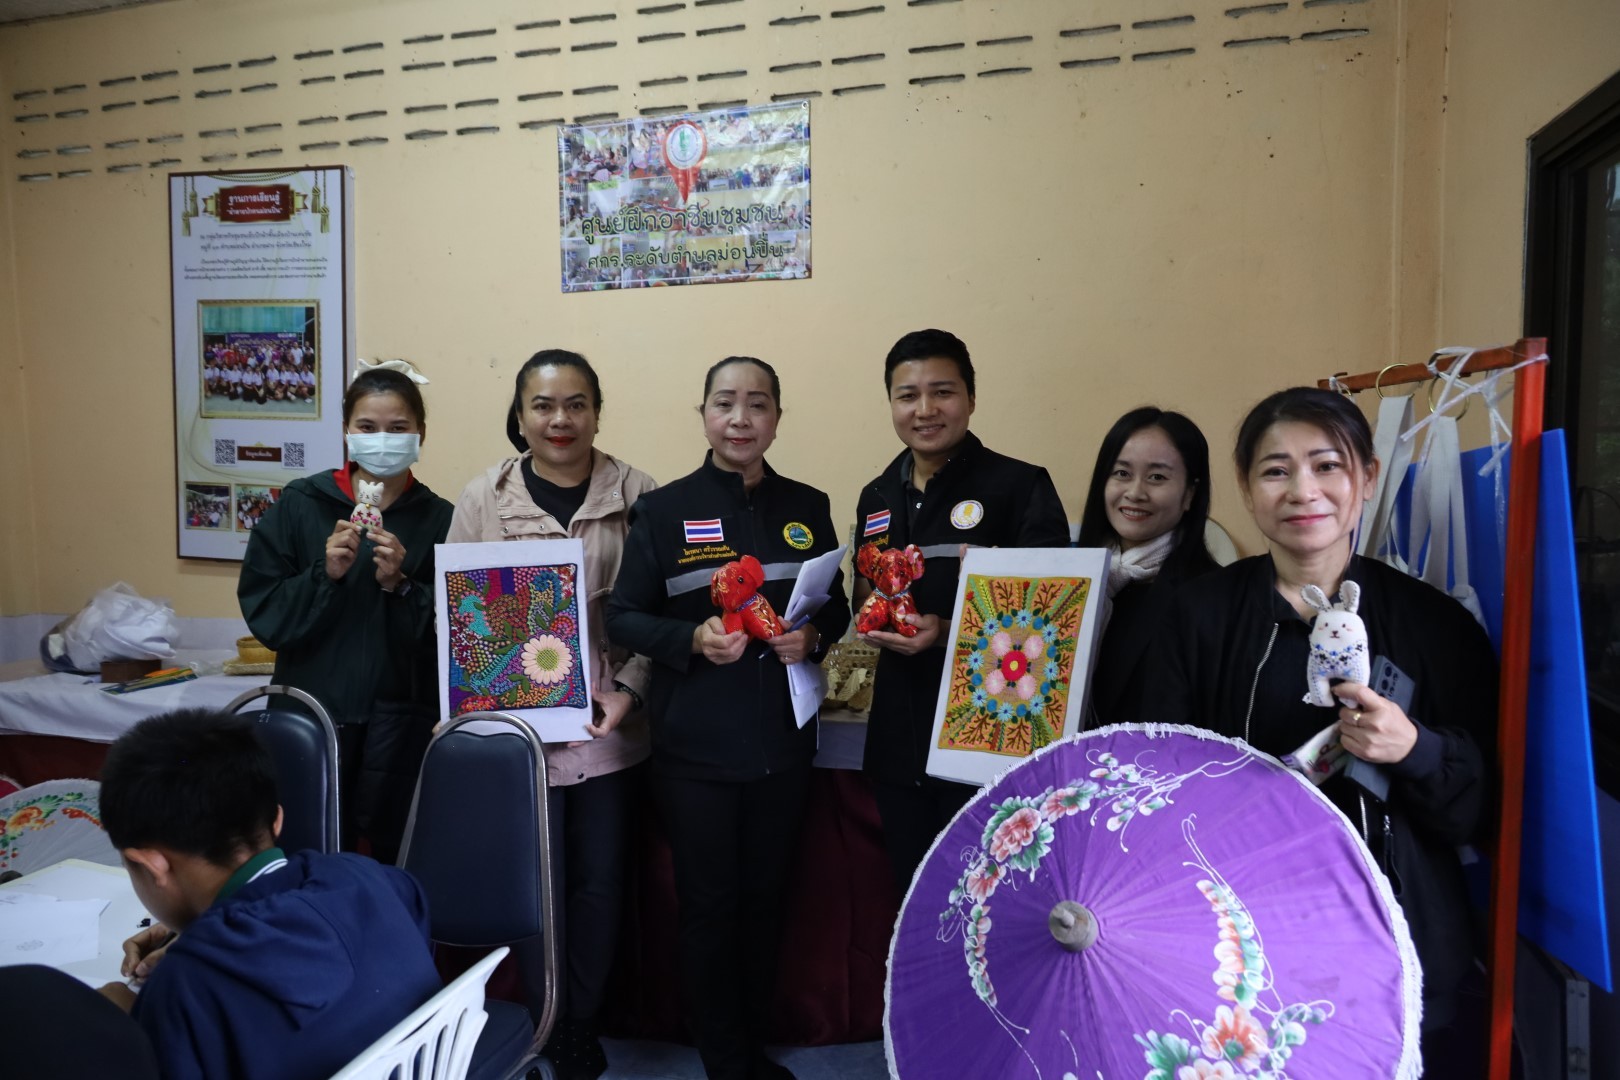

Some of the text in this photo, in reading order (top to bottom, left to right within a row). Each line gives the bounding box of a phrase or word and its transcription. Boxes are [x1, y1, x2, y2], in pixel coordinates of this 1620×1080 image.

[581, 202, 783, 245] ศูนย์ฝึกอาชีพชุมชน
[588, 233, 784, 268] ศกร.ระดับตำบลม่อนปิ่น
[259, 713, 270, 723] 21
